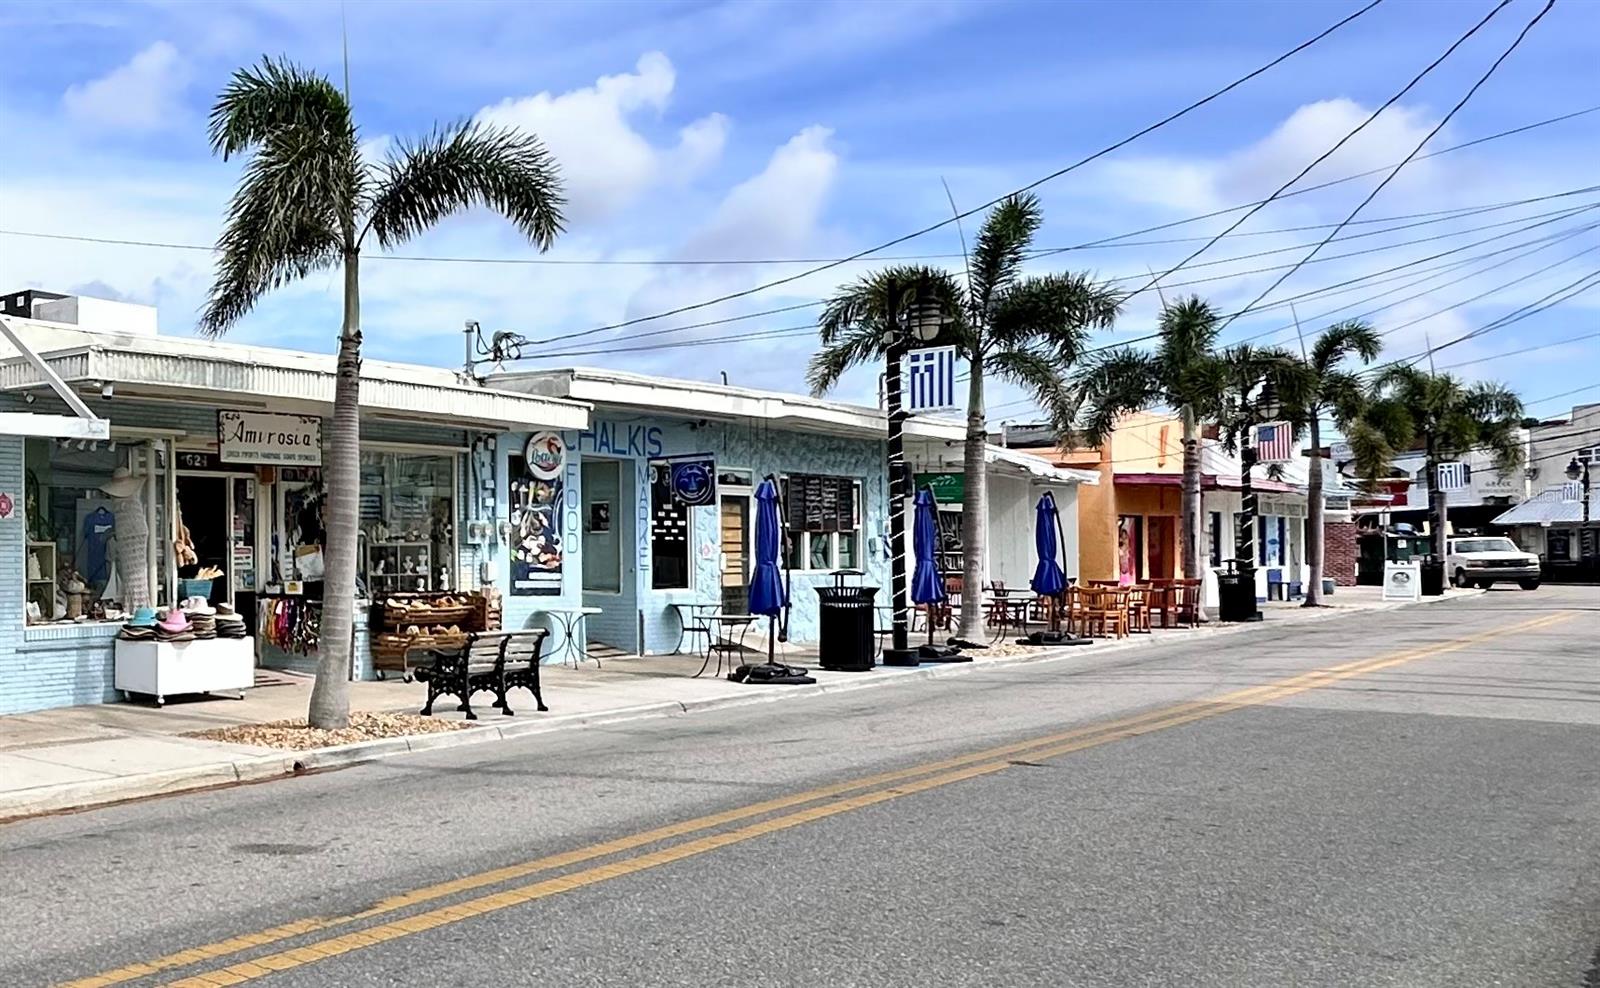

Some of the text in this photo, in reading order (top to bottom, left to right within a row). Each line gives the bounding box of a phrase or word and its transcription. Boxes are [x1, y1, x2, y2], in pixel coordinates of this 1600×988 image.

[227, 420, 311, 446] Amirosia
[561, 420, 662, 457] CHALKIS
[566, 463, 578, 554] FOOD
[638, 465, 650, 590] MARKET
